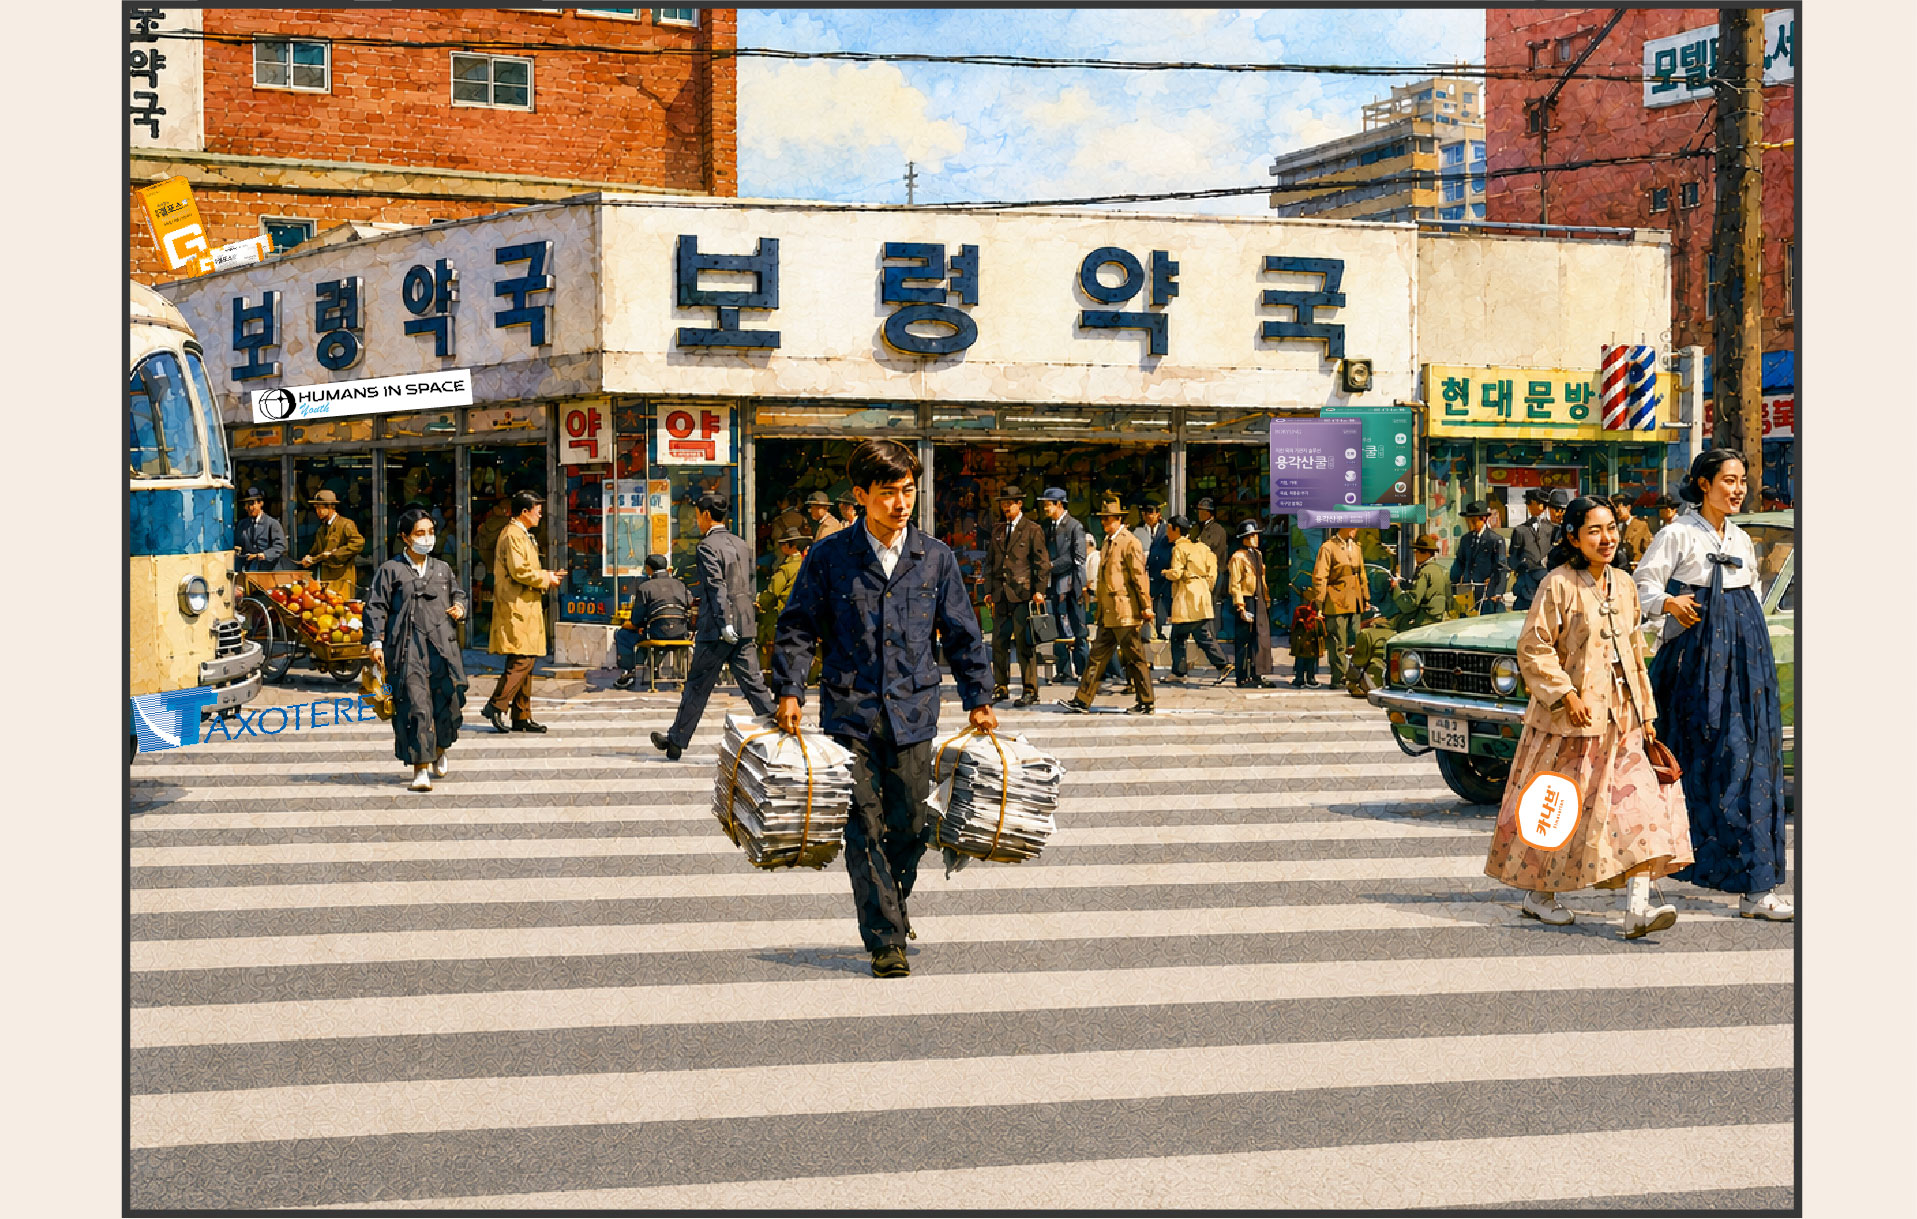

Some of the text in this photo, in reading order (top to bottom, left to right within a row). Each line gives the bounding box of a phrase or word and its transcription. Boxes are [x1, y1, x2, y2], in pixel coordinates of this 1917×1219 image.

[232, 241, 555, 382] 보령약국
[675, 234, 1346, 361] 보령약국
[298, 380, 466, 402] HUMANS IN SPACE
[299, 402, 330, 417] Youth
[566, 407, 602, 459] 약
[665, 410, 720, 461] 약
[1275, 455, 1328, 470] 용각산쿨
[1536, 789, 1560, 837] 카나브
